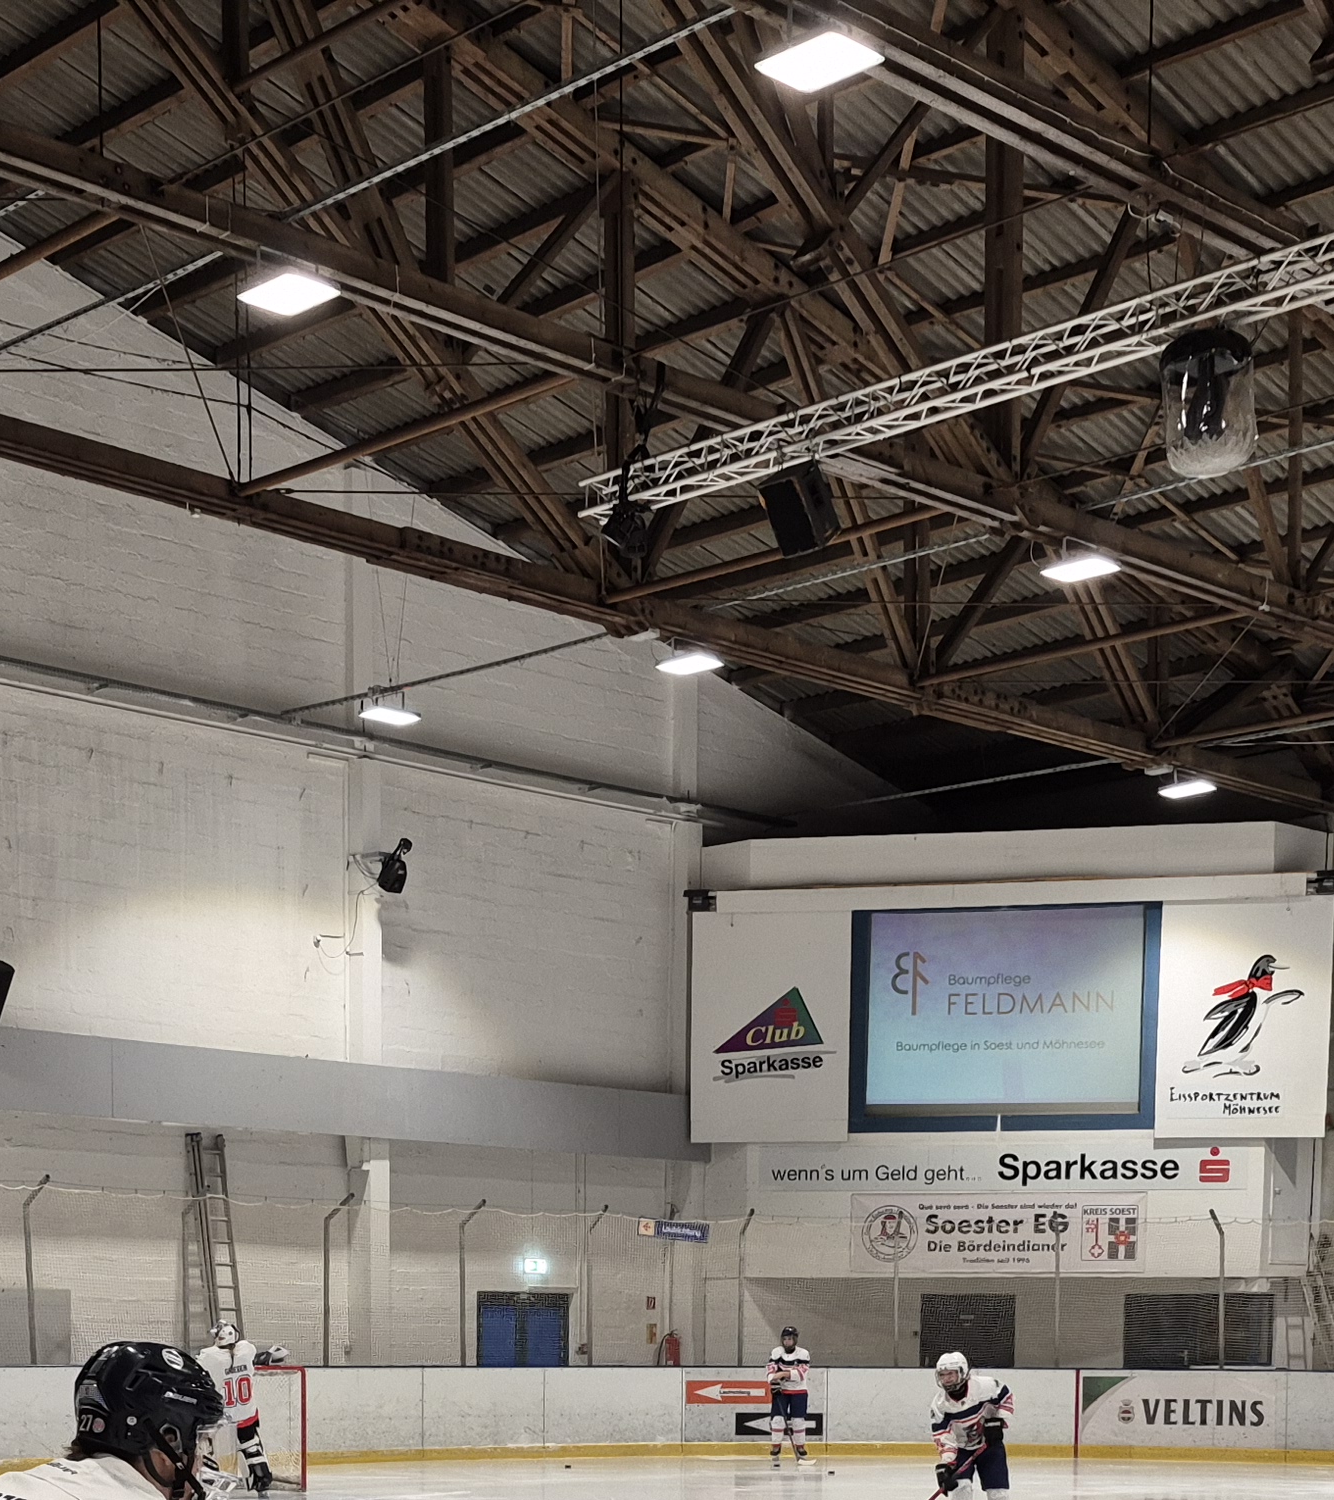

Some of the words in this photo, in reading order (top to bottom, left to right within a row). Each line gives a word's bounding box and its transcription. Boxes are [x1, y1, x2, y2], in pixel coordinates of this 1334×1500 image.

[947, 973, 1032, 987] Baumpflege
[947, 990, 1115, 1016] FELDMANN
[746, 1021, 805, 1046] Club
[896, 1040, 967, 1053] Baumpflege
[970, 1039, 980, 1050] in
[983, 1039, 1013, 1051] Soest
[1016, 1039, 1040, 1050] und
[1042, 1039, 1106, 1050] Möhnesee
[720, 1055, 824, 1079] Sparkasse
[840, 1167, 869, 1182] um
[875, 1164, 918, 1182] Geld
[997, 1153, 1180, 1187] Sparkasse
[1083, 1207, 1108, 1216] KREIS
[1109, 1207, 1137, 1216] SOEST
[924, 1213, 1025, 1235] Soester
[1033, 1212, 1070, 1234] EG
[927, 1240, 952, 1252] Die
[223, 1375, 253, 1408] 10
[79, 1414, 93, 1432] 27
[1141, 1399, 1265, 1427] VELTINS
